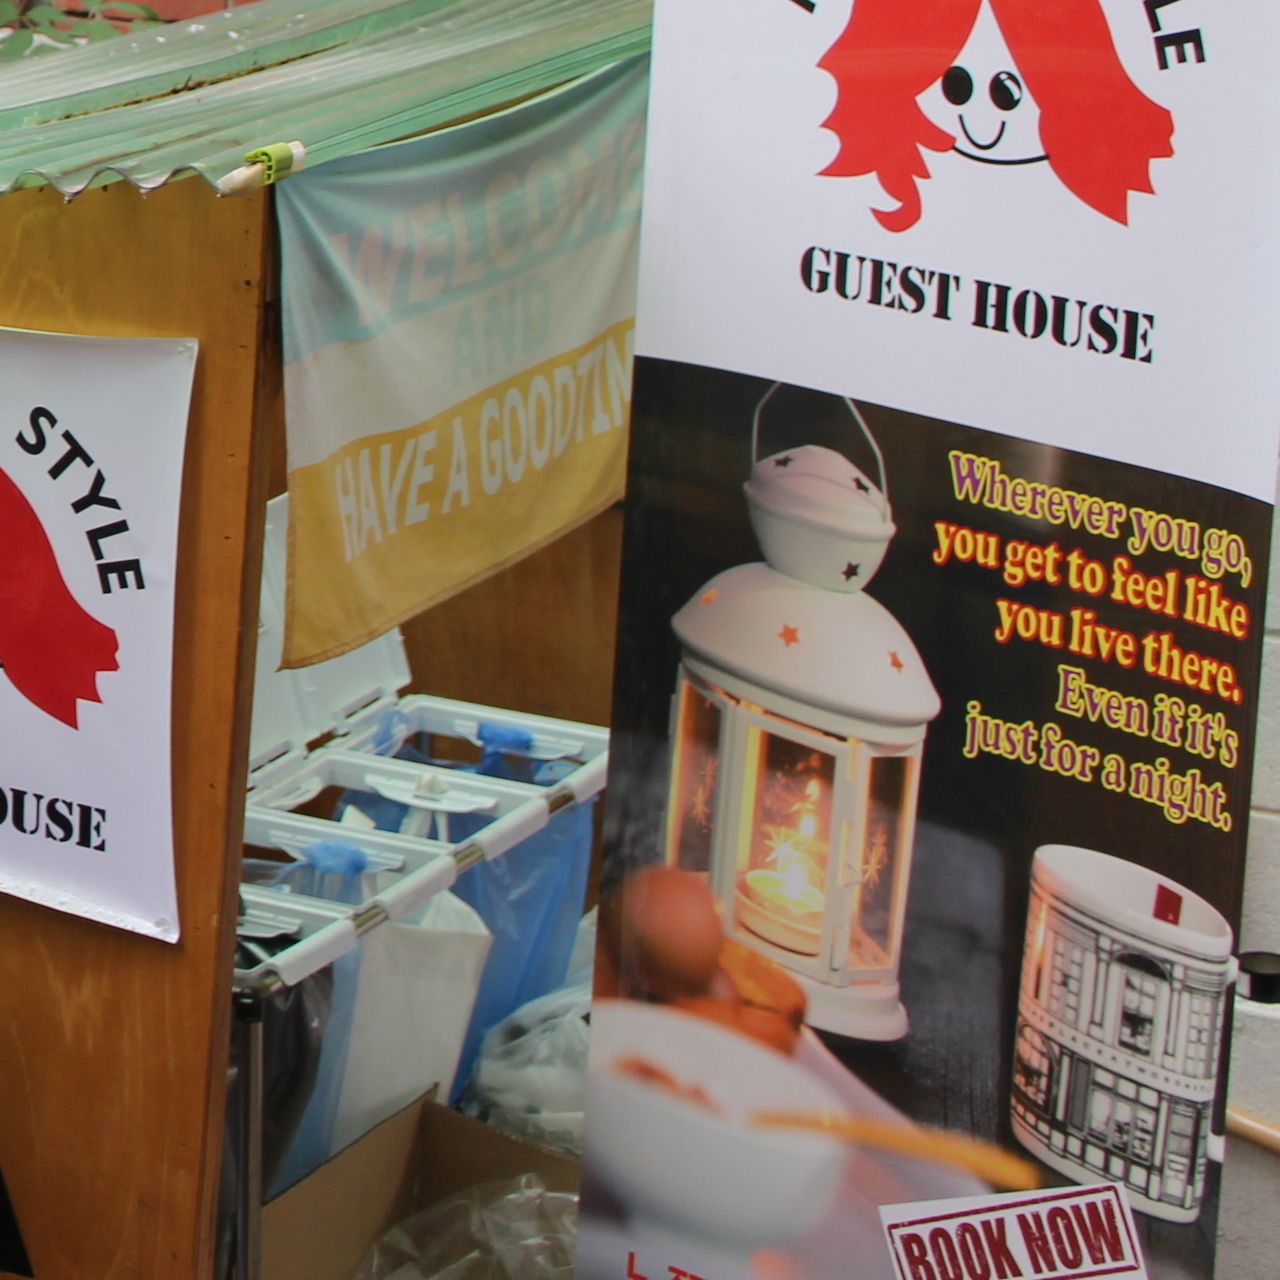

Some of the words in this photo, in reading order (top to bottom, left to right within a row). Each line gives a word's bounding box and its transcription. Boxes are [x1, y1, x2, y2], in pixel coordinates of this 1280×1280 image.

[453, 272, 552, 388] AND
[799, 245, 960, 321] GUEST
[972, 279, 1156, 364] HOUSE
[15, 406, 146, 595] STYLE
[335, 429, 437, 564] HAVE
[441, 417, 471, 515] A
[479, 364, 576, 497] GOOD
[948, 450, 1126, 539] Wherever
[1128, 506, 1200, 560] you
[1202, 527, 1252, 589] go,
[932, 519, 1000, 570] you
[1002, 540, 1062, 588] get
[1066, 547, 1106, 595] to
[1110, 554, 1179, 618] feel
[1183, 573, 1250, 638] like
[994, 597, 1063, 648] you
[1068, 606, 1138, 668] live
[1142, 631, 1243, 704] there.
[963, 701, 1038, 763] just
[1040, 723, 1099, 782] for
[1101, 753, 1125, 793] a
[1129, 757, 1232, 832] night.
[1056, 664, 1148, 737] Even
[1151, 693, 1185, 747] if
[1186, 704, 1239, 768] it's
[899, 1217, 1022, 1280] BOOK
[1017, 1199, 1125, 1274] NOW
